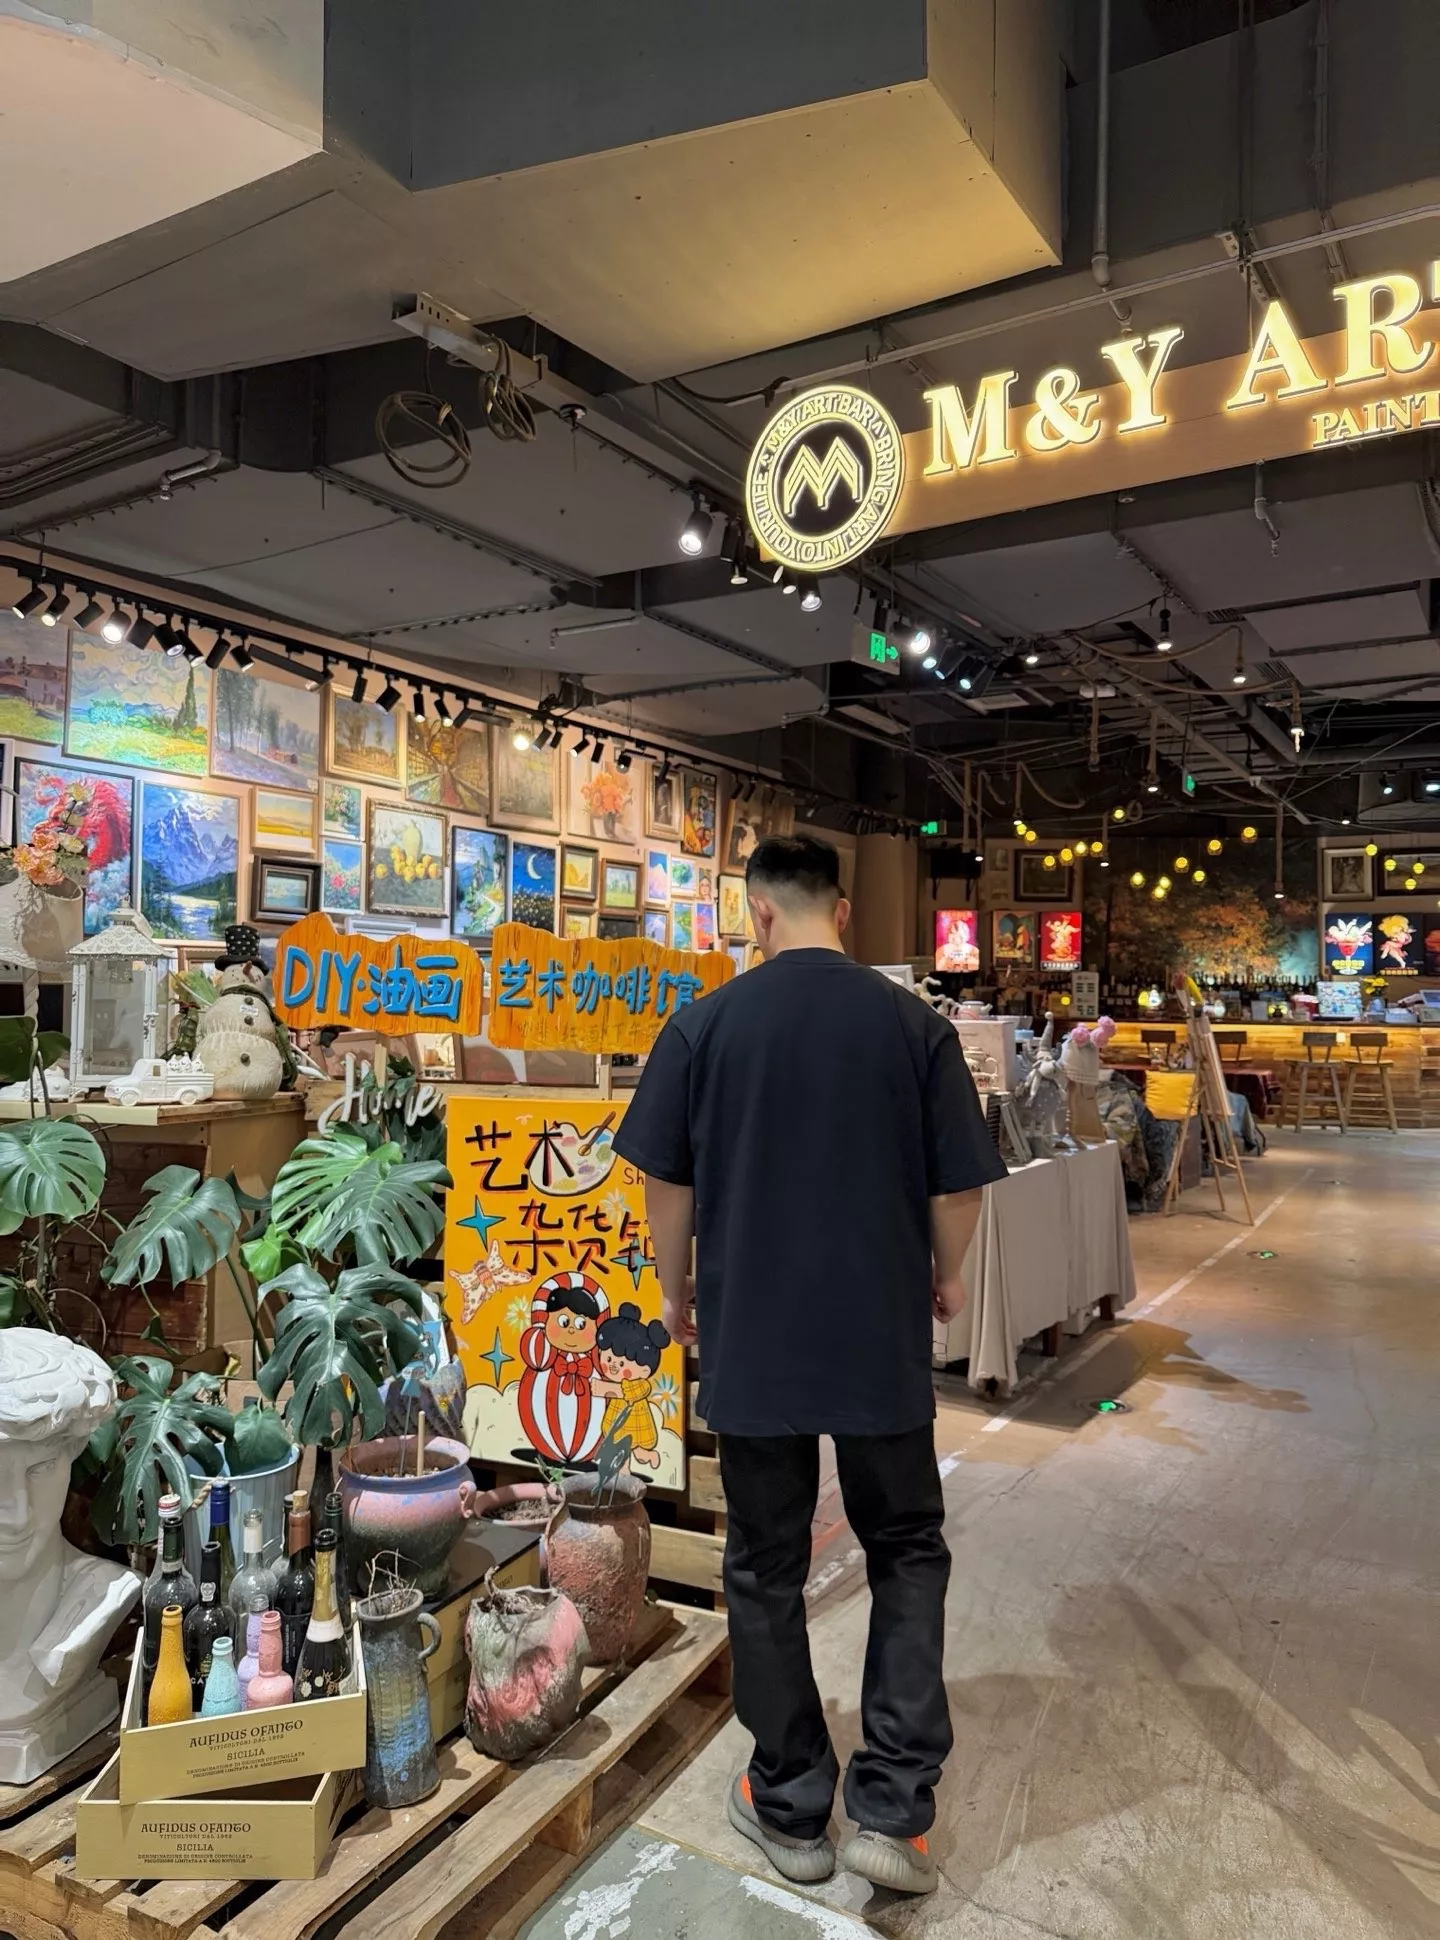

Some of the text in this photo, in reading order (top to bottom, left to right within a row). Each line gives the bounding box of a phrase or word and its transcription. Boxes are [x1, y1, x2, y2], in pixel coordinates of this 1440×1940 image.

[923, 260, 1440, 477] M&Y AR
[800, 395, 837, 421] ART
[838, 394, 874, 427] BAR
[498, 957, 704, 1017] 艺术咖啡馆
[465, 1119, 575, 1192] 艺术
[189, 1719, 304, 1748] AUFIDUS OFANTO
[226, 1747, 266, 1761] SICILIA
[141, 1823, 251, 1833] AUFIDUS OFANTO
[176, 1843, 214, 1851] SICILIA
